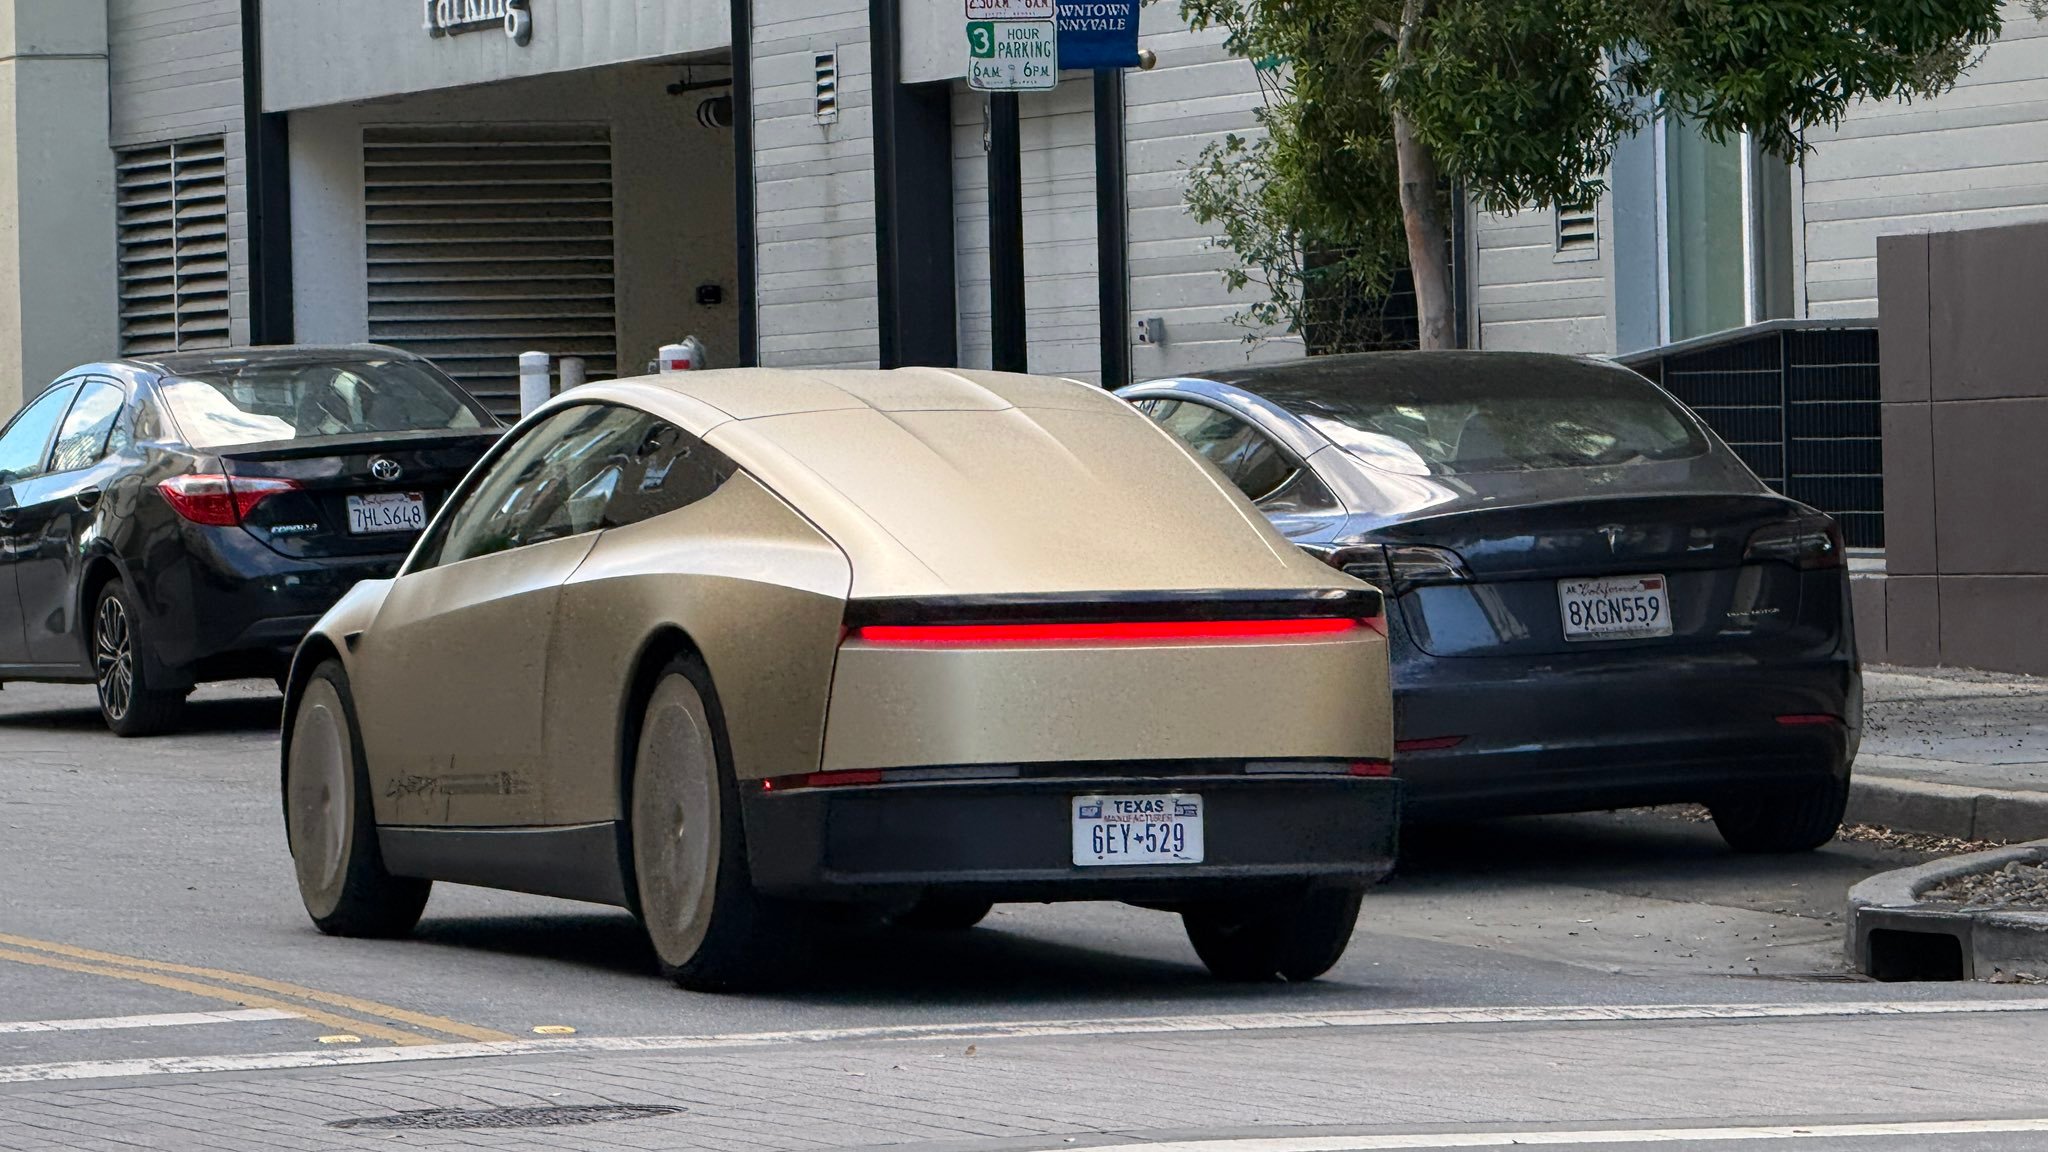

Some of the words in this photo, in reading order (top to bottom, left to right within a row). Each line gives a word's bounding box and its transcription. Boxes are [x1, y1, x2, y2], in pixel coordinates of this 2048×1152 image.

[1055, 4, 1130, 17] WNTOWN
[1059, 19, 1126, 31] NNYVALE
[973, 28, 990, 54] 3
[1007, 29, 1040, 40] HOUR
[998, 41, 1051, 59] PARKING
[973, 61, 1001, 78] 6AM
[1023, 61, 1050, 77] 6PM
[353, 505, 421, 528] 7HLS648
[1568, 596, 1660, 627] 8XGN559
[1114, 799, 1165, 814] TEXAS
